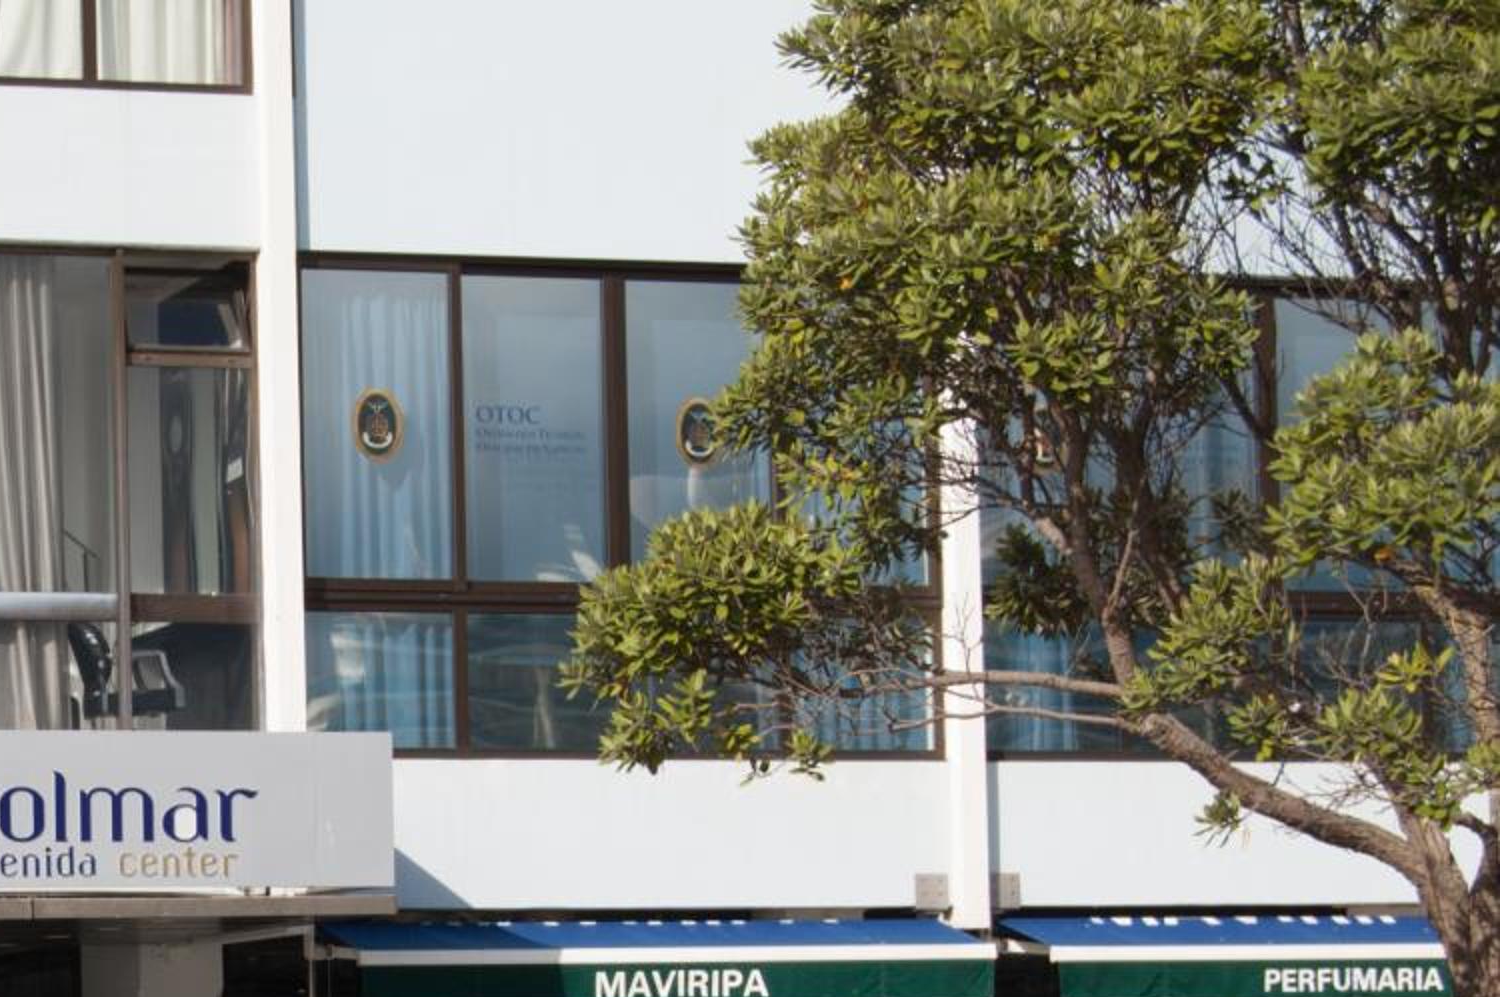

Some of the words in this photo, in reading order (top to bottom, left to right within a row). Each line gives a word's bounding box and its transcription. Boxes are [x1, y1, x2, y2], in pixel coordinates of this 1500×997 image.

[476, 404, 541, 425] OTOC
[118, 847, 239, 878] center
[1263, 966, 1444, 993] PERFUMARIA
